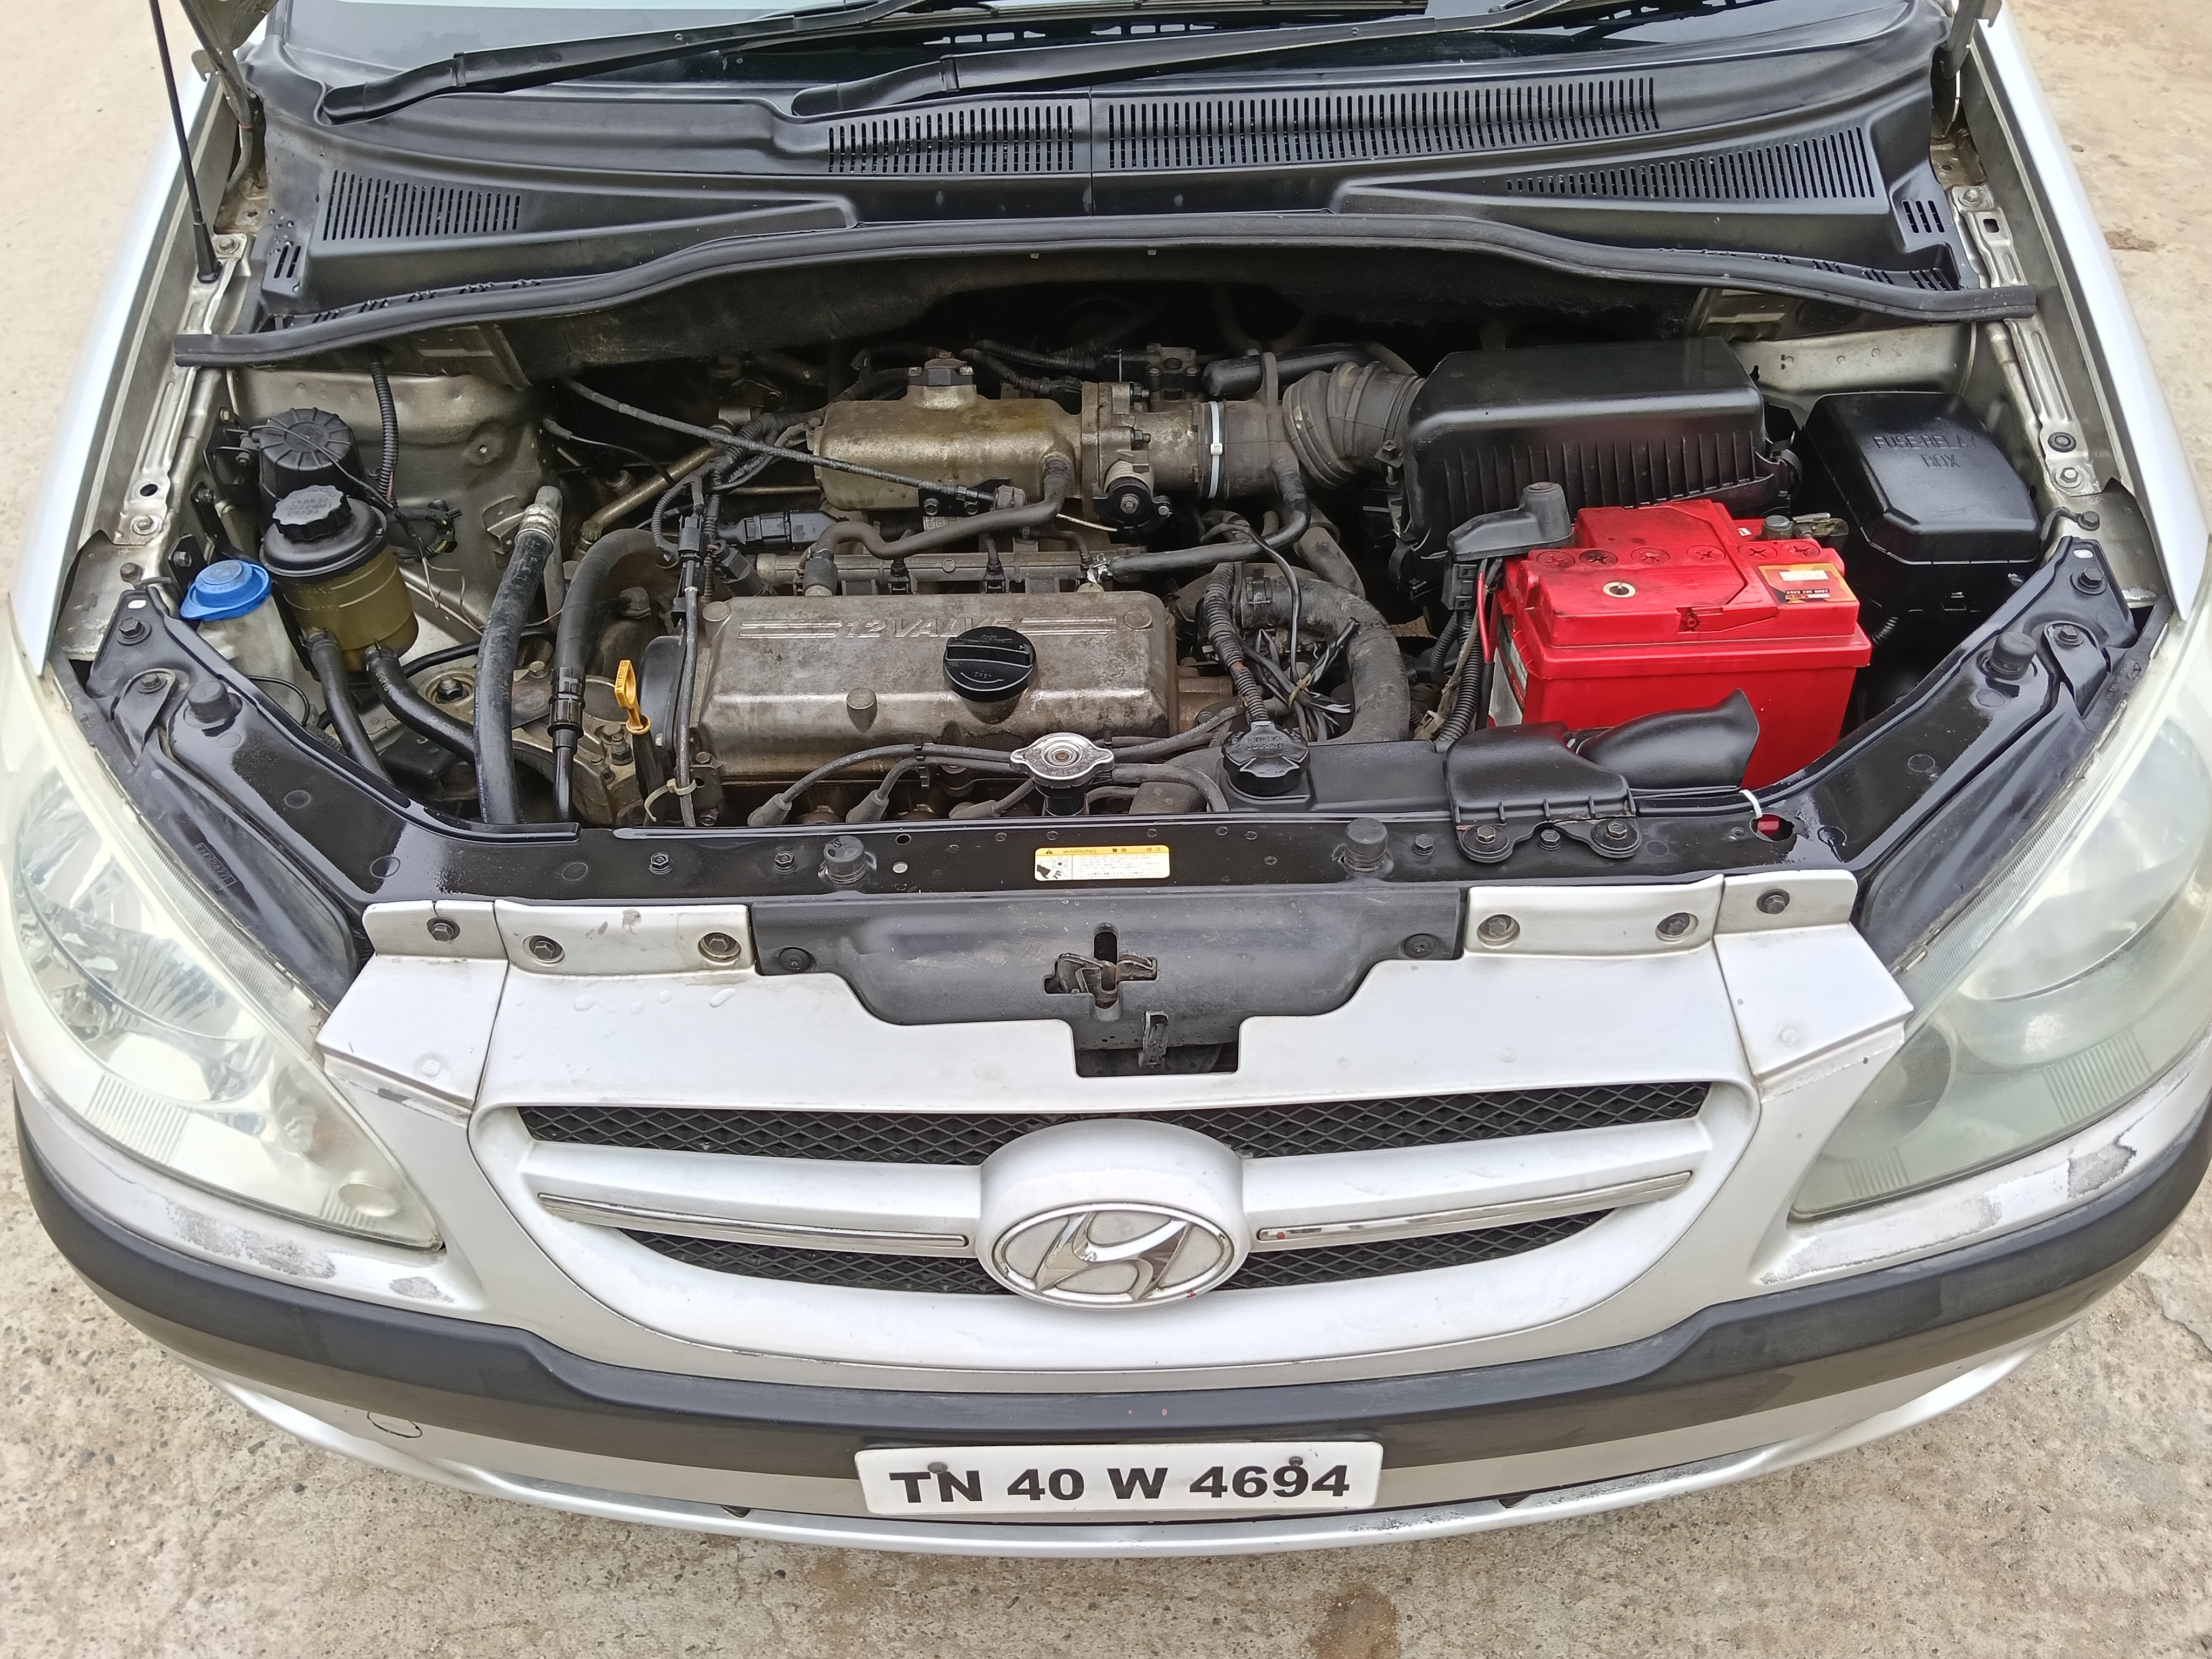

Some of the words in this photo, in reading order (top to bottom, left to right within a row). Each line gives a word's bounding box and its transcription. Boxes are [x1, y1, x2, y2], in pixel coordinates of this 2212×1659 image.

[1874, 434, 1976, 450] FUSE-RELAY
[1922, 454, 1960, 469] BOX
[846, 618, 886, 638] 12
[889, 1470, 982, 1503] TN
[1007, 1468, 1085, 1501] 40
[1108, 1467, 1169, 1499] W
[1189, 1464, 1351, 1498] 4694
